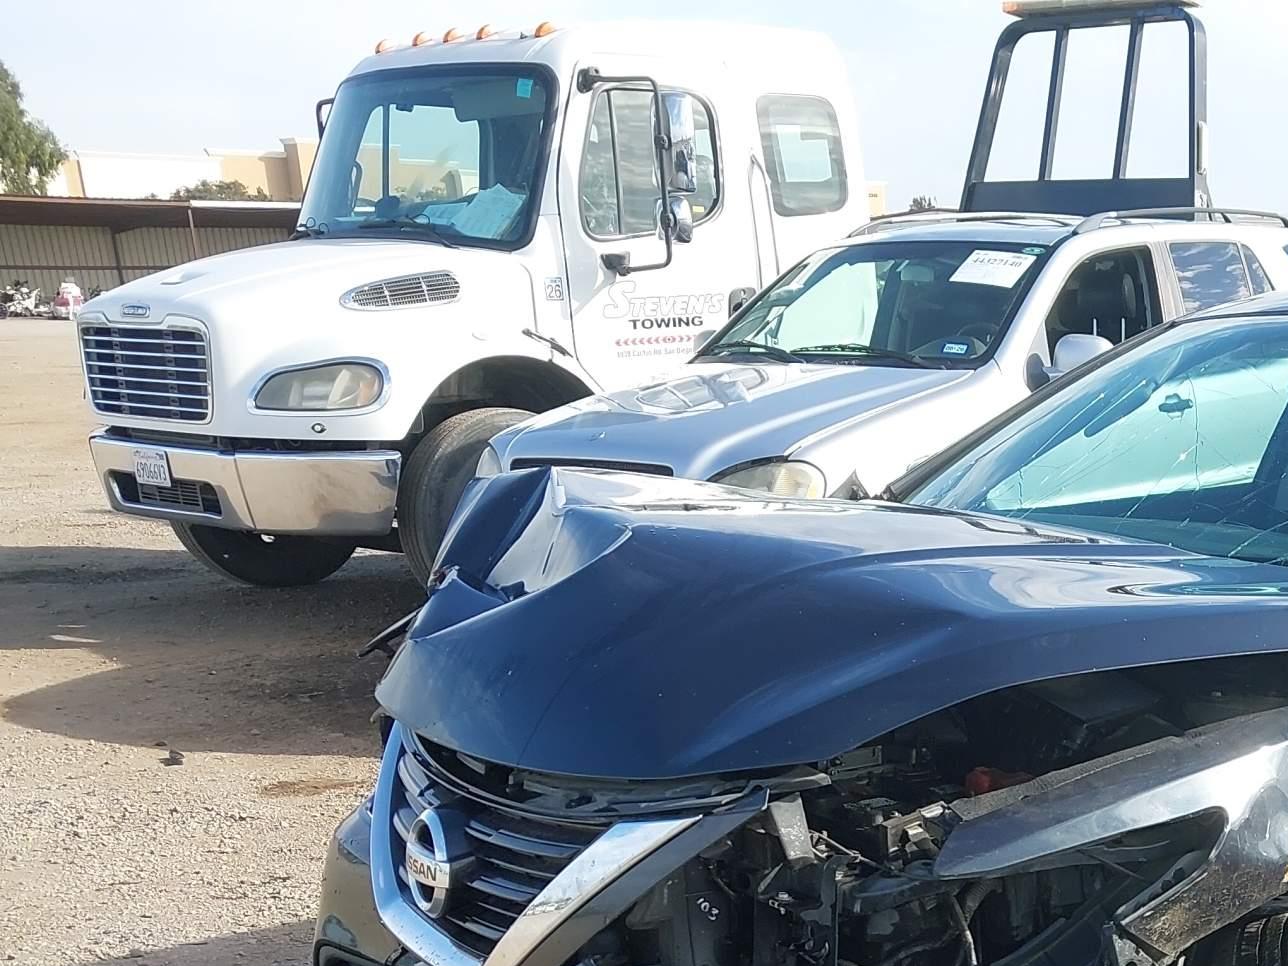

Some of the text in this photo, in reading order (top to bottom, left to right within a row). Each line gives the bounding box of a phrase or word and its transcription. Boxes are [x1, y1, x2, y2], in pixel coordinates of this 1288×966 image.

[546, 283, 562, 299] 26
[628, 316, 703, 330] TOWING
[408, 855, 437, 881] SSAN
[696, 897, 720, 921] 103
